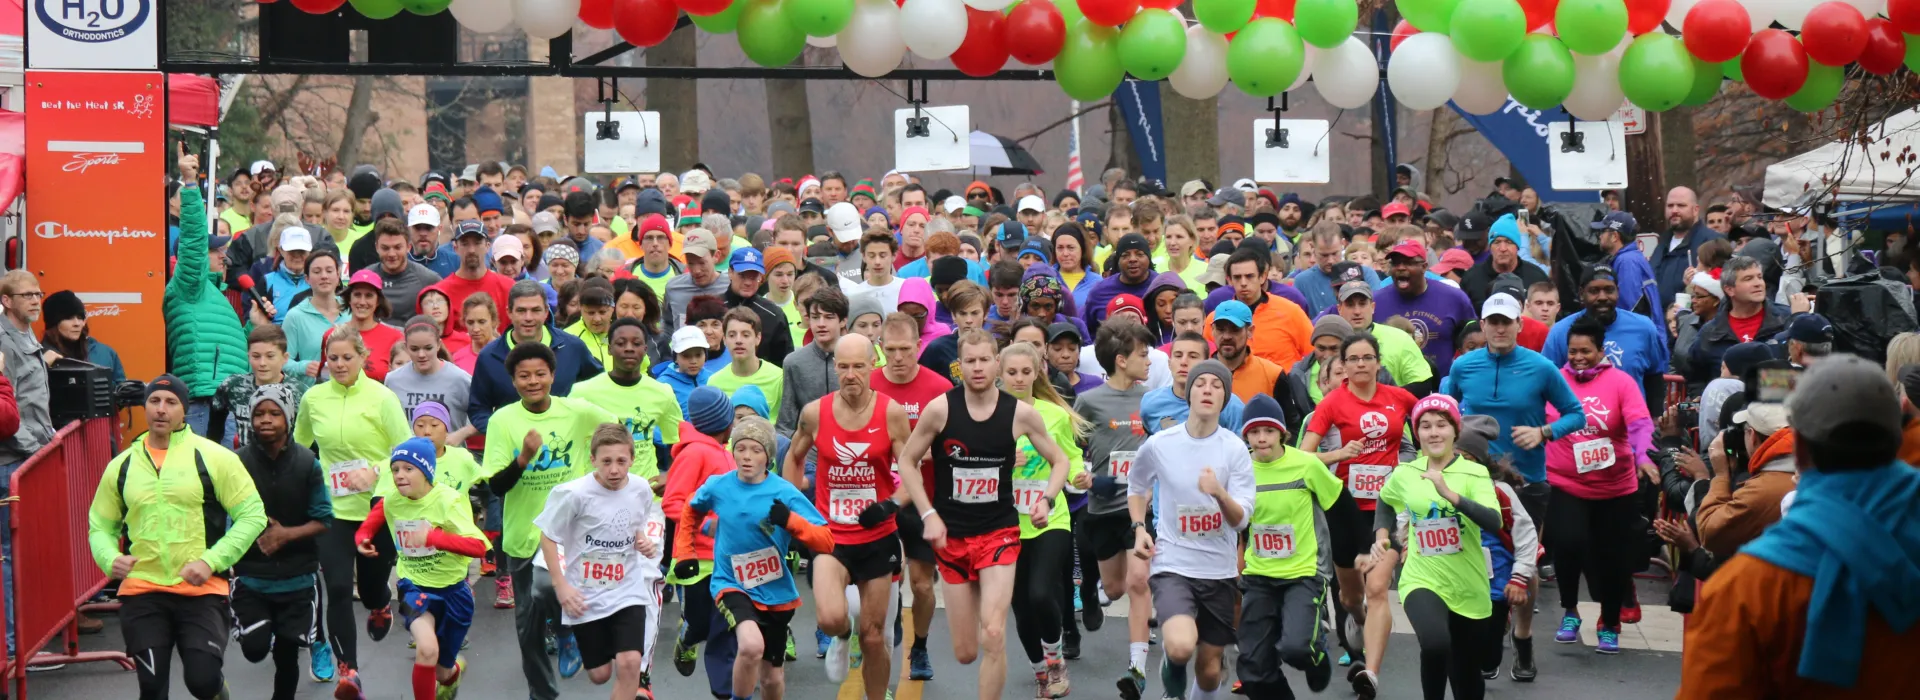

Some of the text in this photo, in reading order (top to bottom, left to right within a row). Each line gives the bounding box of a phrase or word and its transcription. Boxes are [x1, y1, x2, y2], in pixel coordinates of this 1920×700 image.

[62, 0, 124, 28] H2O
[62, 28, 125, 41] ORTHODONTICS
[41, 101, 62, 109] Beat
[66, 100, 82, 110] the
[85, 101, 109, 110] Heat
[62, 152, 126, 174] Sports
[34, 221, 157, 245] Champion
[85, 304, 127, 318] ports
[903, 402, 919, 413] ing
[1581, 447, 1609, 466] 646
[828, 466, 875, 477] ATLANTA
[1111, 460, 1130, 477] 14
[331, 471, 350, 490] 13
[955, 478, 998, 495] 1720
[1355, 474, 1386, 492] 588
[1014, 488, 1044, 506] 117
[1179, 512, 1222, 533] 1569
[585, 534, 624, 548] Precious
[1253, 533, 1292, 551] 1051
[1417, 527, 1459, 549] 1003
[583, 561, 625, 582] 1649
[734, 555, 780, 582] 1250
